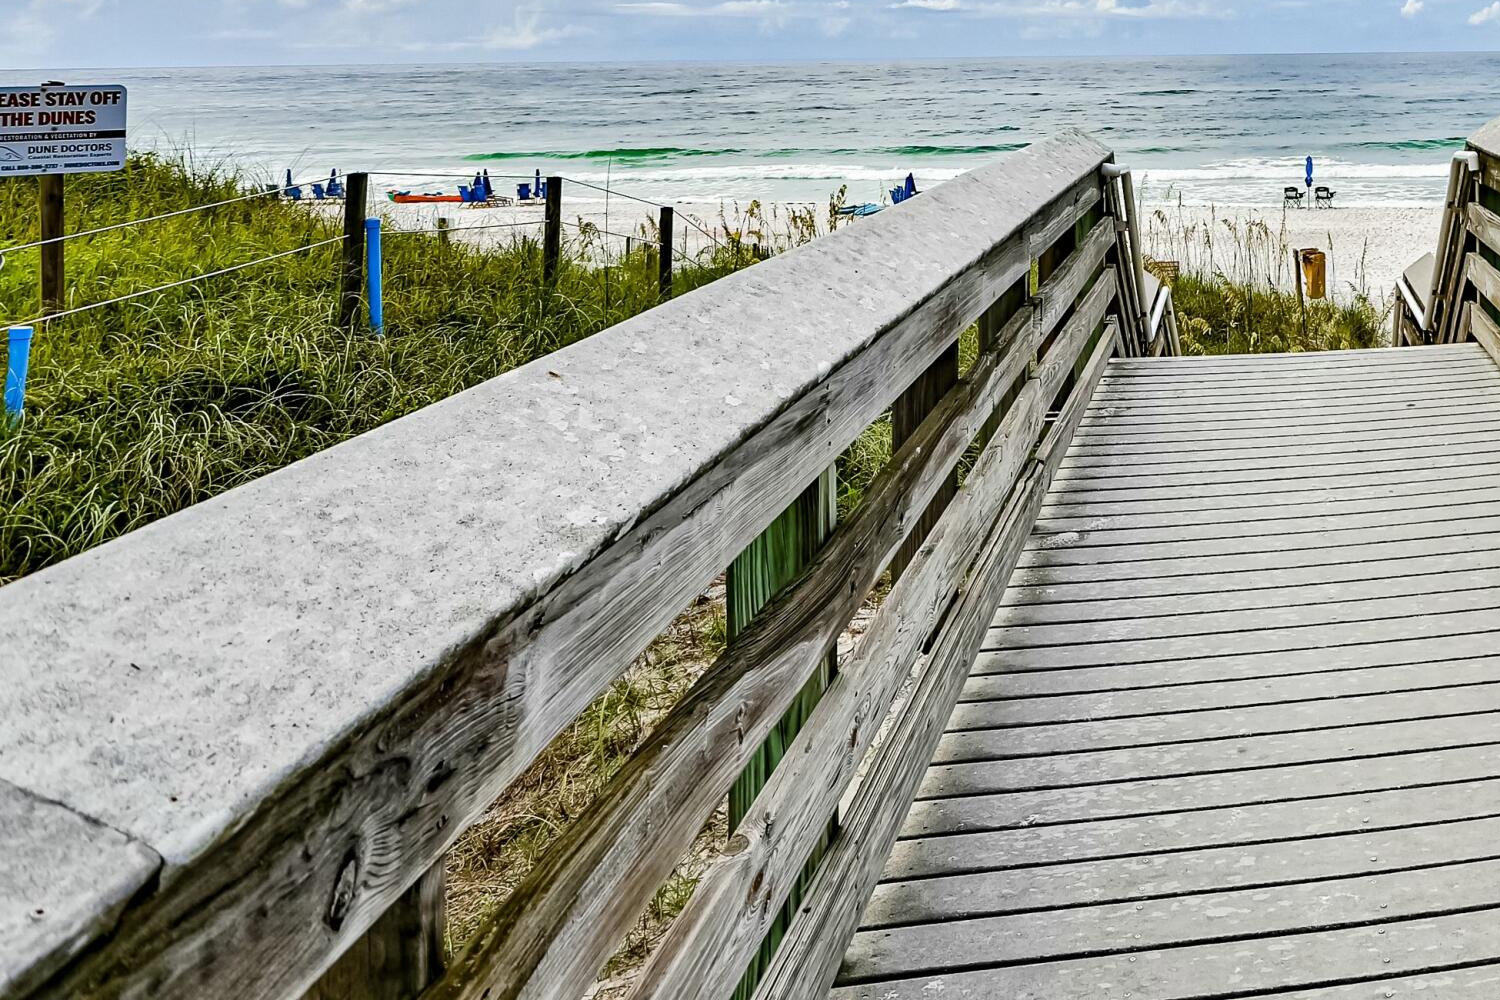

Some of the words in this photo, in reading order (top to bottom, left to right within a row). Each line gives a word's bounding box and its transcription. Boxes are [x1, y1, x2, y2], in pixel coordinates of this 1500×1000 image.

[0, 93, 41, 107] EASE
[45, 91, 87, 106] STAY
[90, 91, 121, 105] OFF
[0, 112, 34, 126] THE
[38, 110, 97, 125] DUNES
[28, 145, 59, 154] DUNE
[60, 143, 113, 153] DOCTORS
